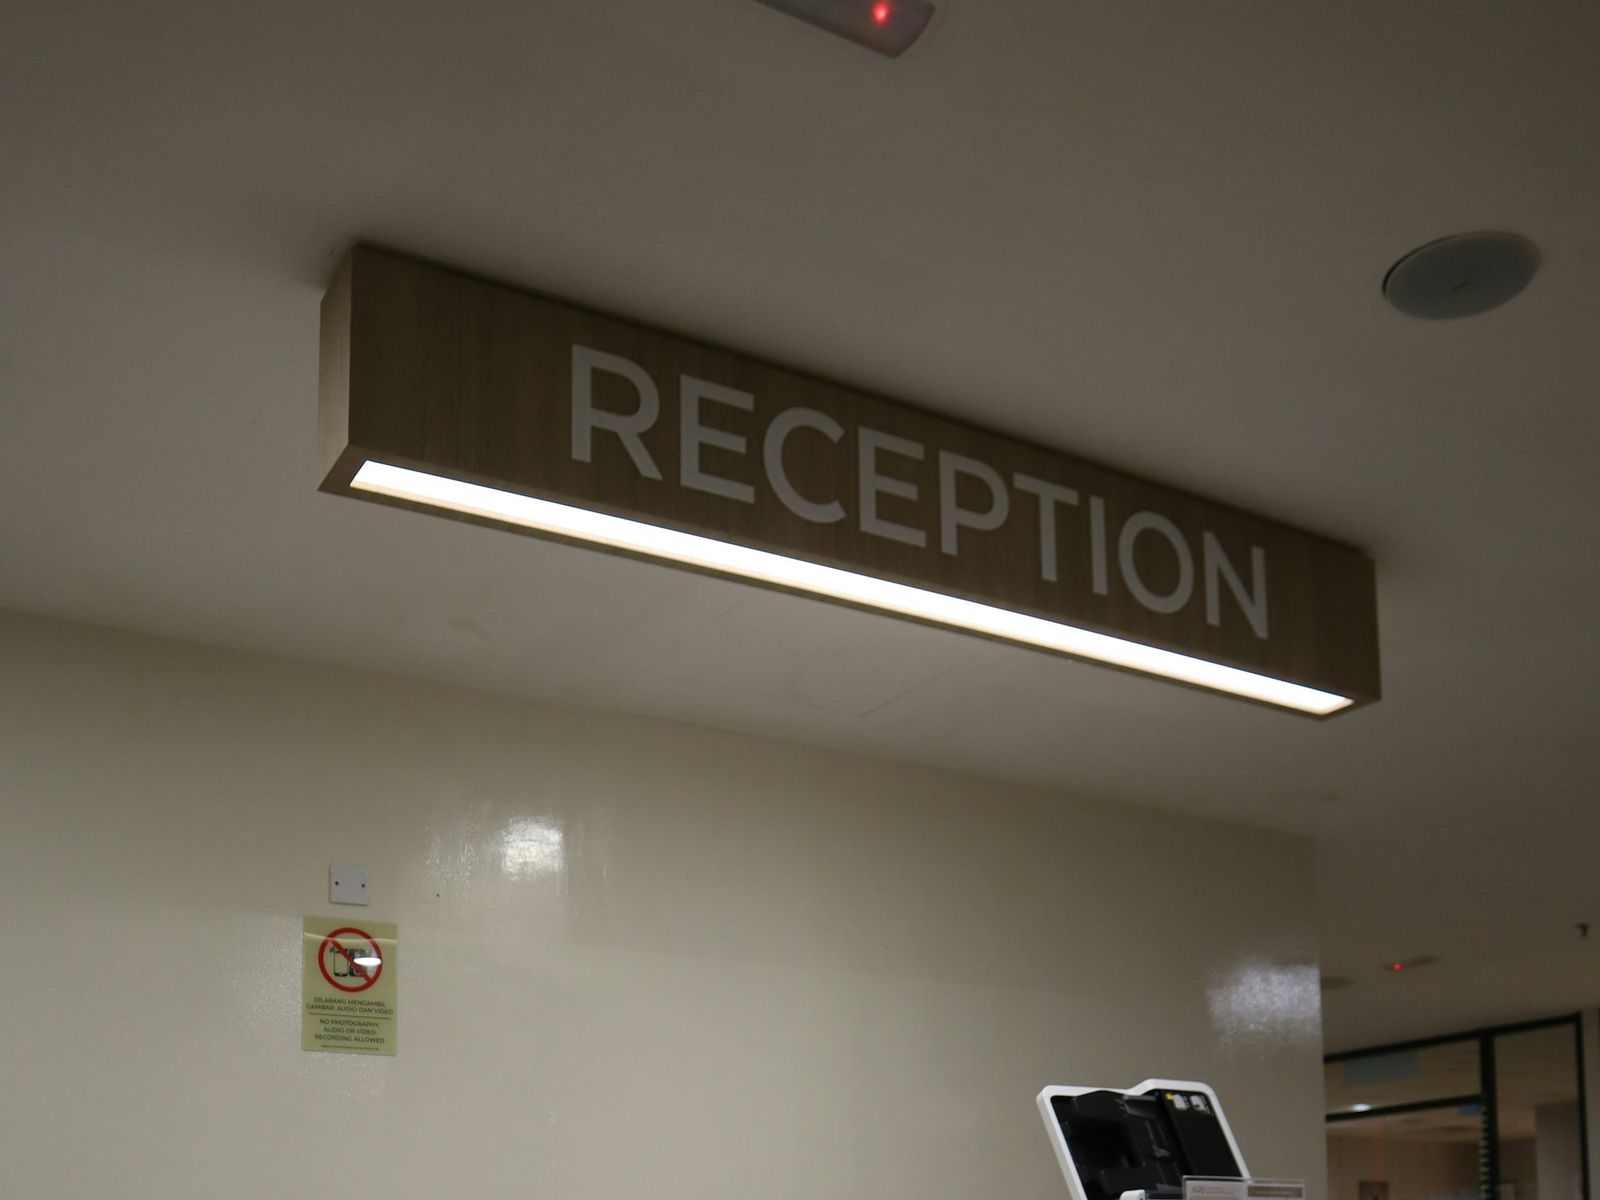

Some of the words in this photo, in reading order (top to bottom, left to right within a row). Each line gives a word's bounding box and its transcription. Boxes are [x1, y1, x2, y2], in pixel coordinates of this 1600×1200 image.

[570, 343, 1269, 639] RECEPTION
[313, 996, 347, 1005] DILARANG
[347, 999, 386, 1007] MENGAMBIL
[314, 1033, 352, 1042] RECORDING
[353, 1035, 385, 1043] ALLOWED
